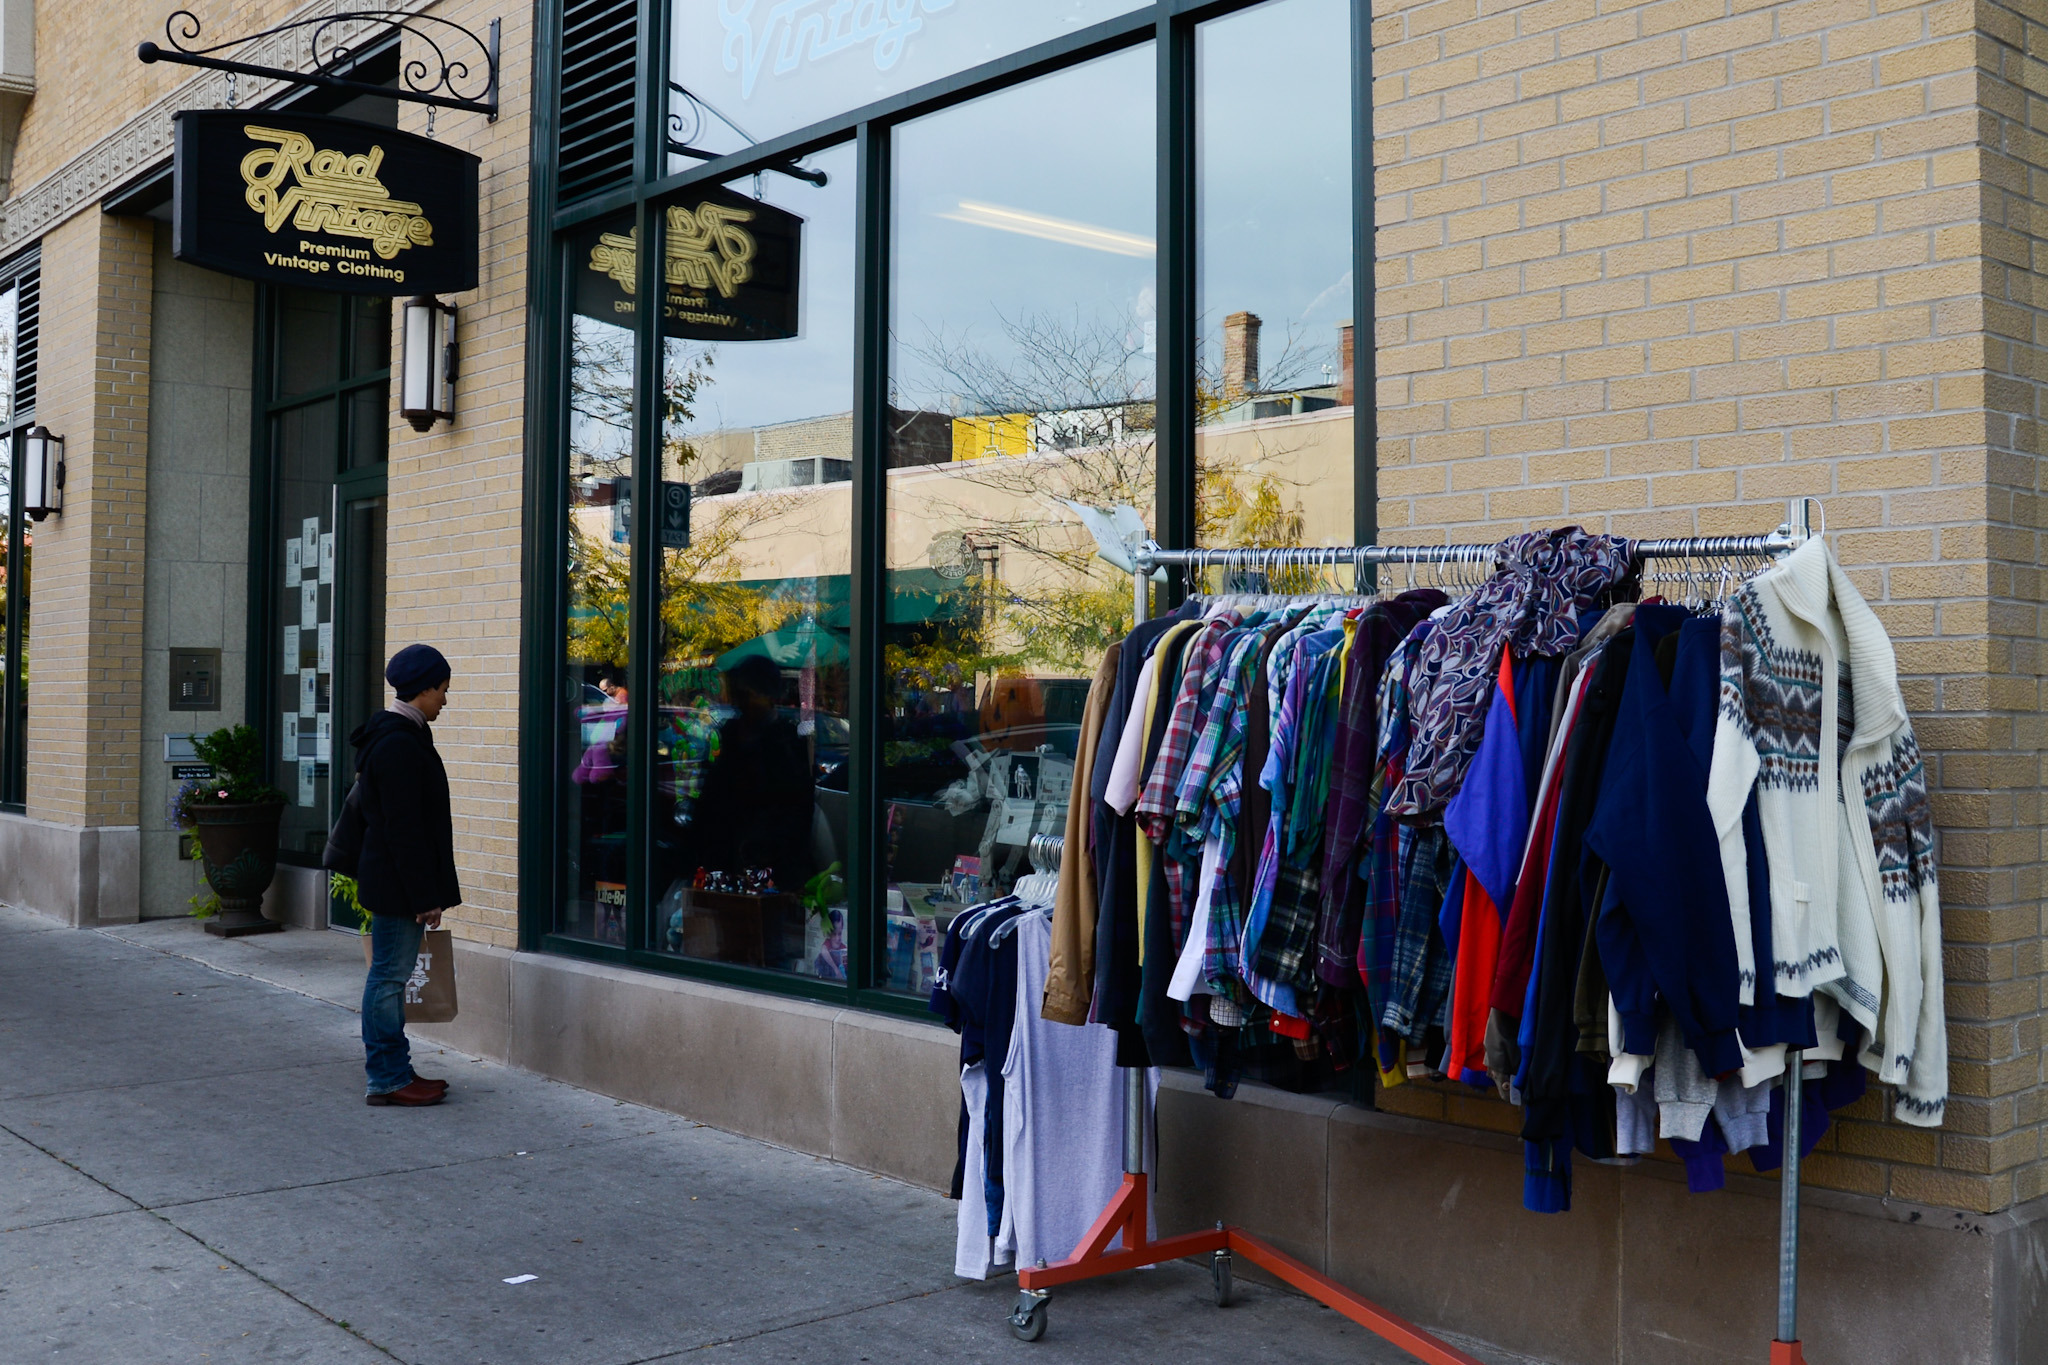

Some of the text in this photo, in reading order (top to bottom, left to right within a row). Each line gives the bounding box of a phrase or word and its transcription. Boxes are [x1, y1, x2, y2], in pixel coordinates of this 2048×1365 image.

[722, 0, 957, 100] Vintag
[240, 124, 390, 198] Rad
[245, 184, 434, 260] Vintage
[299, 240, 370, 261] Premium
[264, 252, 405, 283] Vintage Clothing
